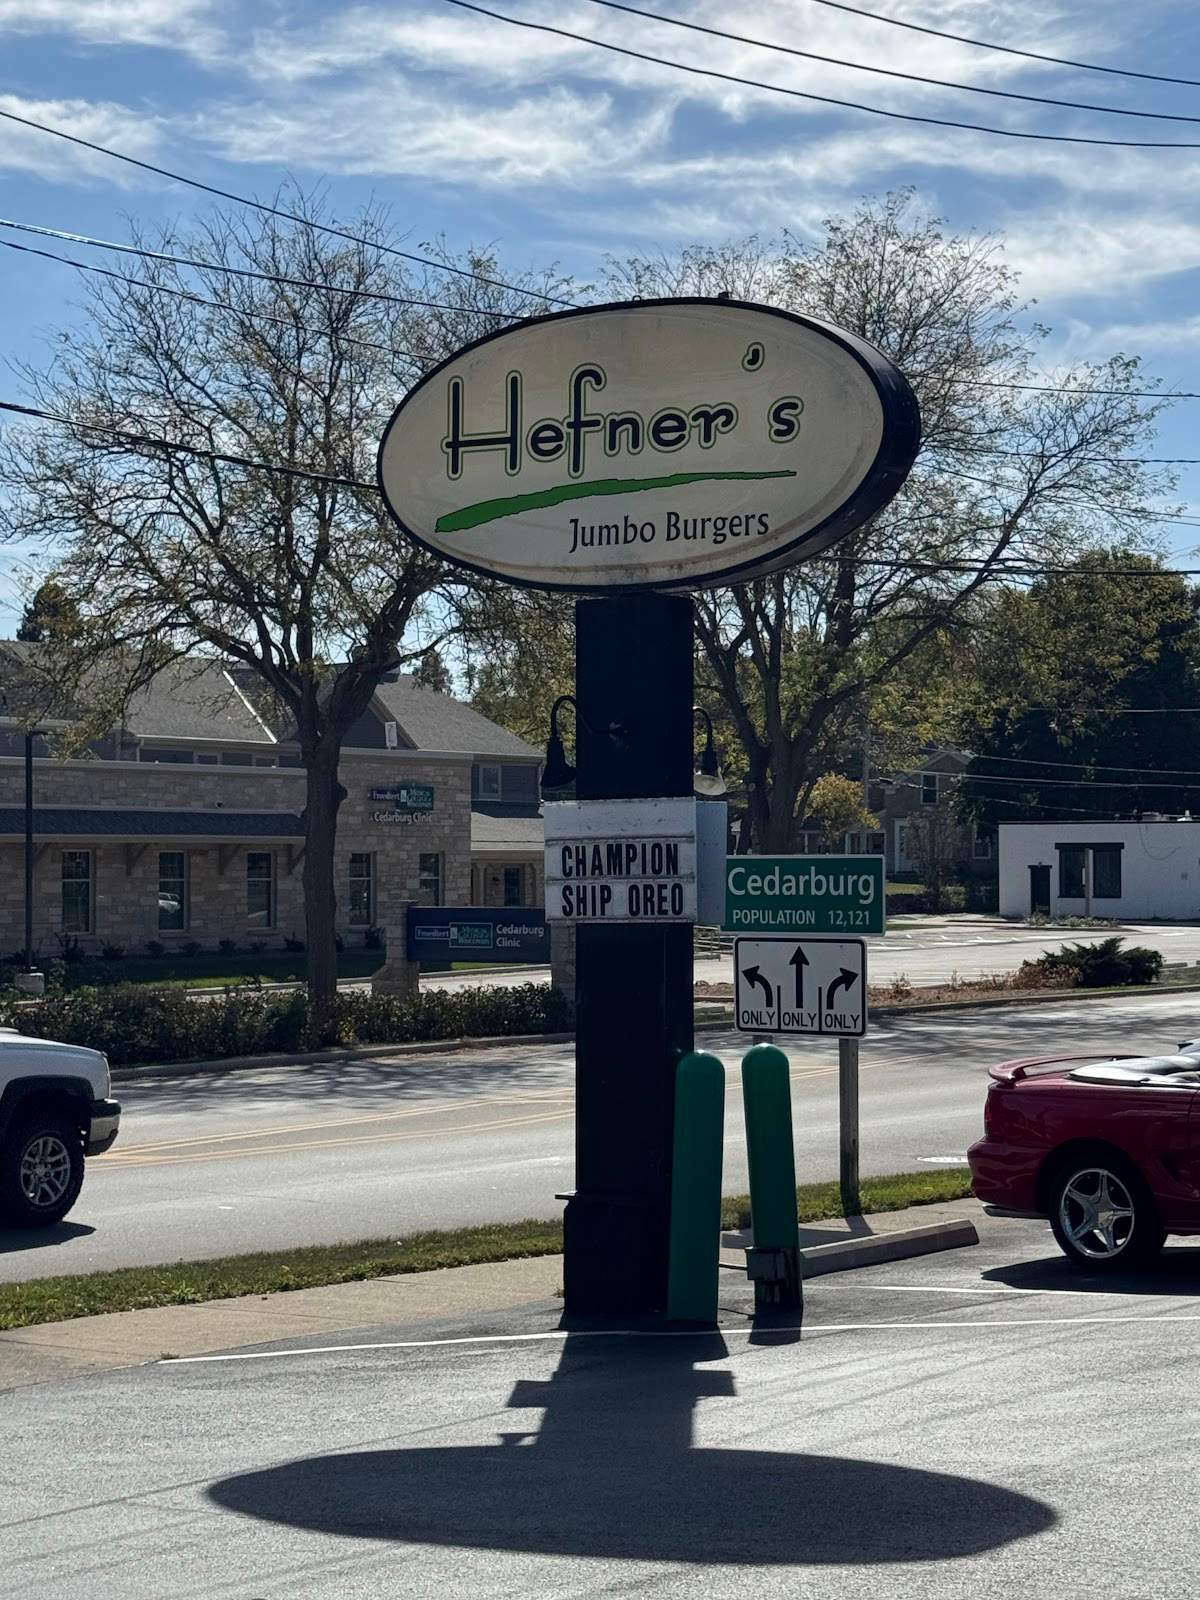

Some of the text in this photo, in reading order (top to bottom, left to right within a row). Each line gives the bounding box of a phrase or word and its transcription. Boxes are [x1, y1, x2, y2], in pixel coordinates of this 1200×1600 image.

[442, 342, 803, 479] Hefner's
[569, 511, 769, 554] Jumbo Burgers
[374, 810, 433, 825] Cedarburg Clinic
[561, 842, 679, 878] CHAMPION
[727, 865, 875, 905] Cedarburg
[561, 883, 684, 917] SHIP OREO
[732, 909, 870, 927] POPULATION 12,121
[495, 924, 545, 937] Cedarburg
[495, 937, 521, 948] Clinic
[741, 1010, 776, 1026] ONLY
[782, 1012, 817, 1028] ONLY
[824, 1014, 860, 1029] ONLY
